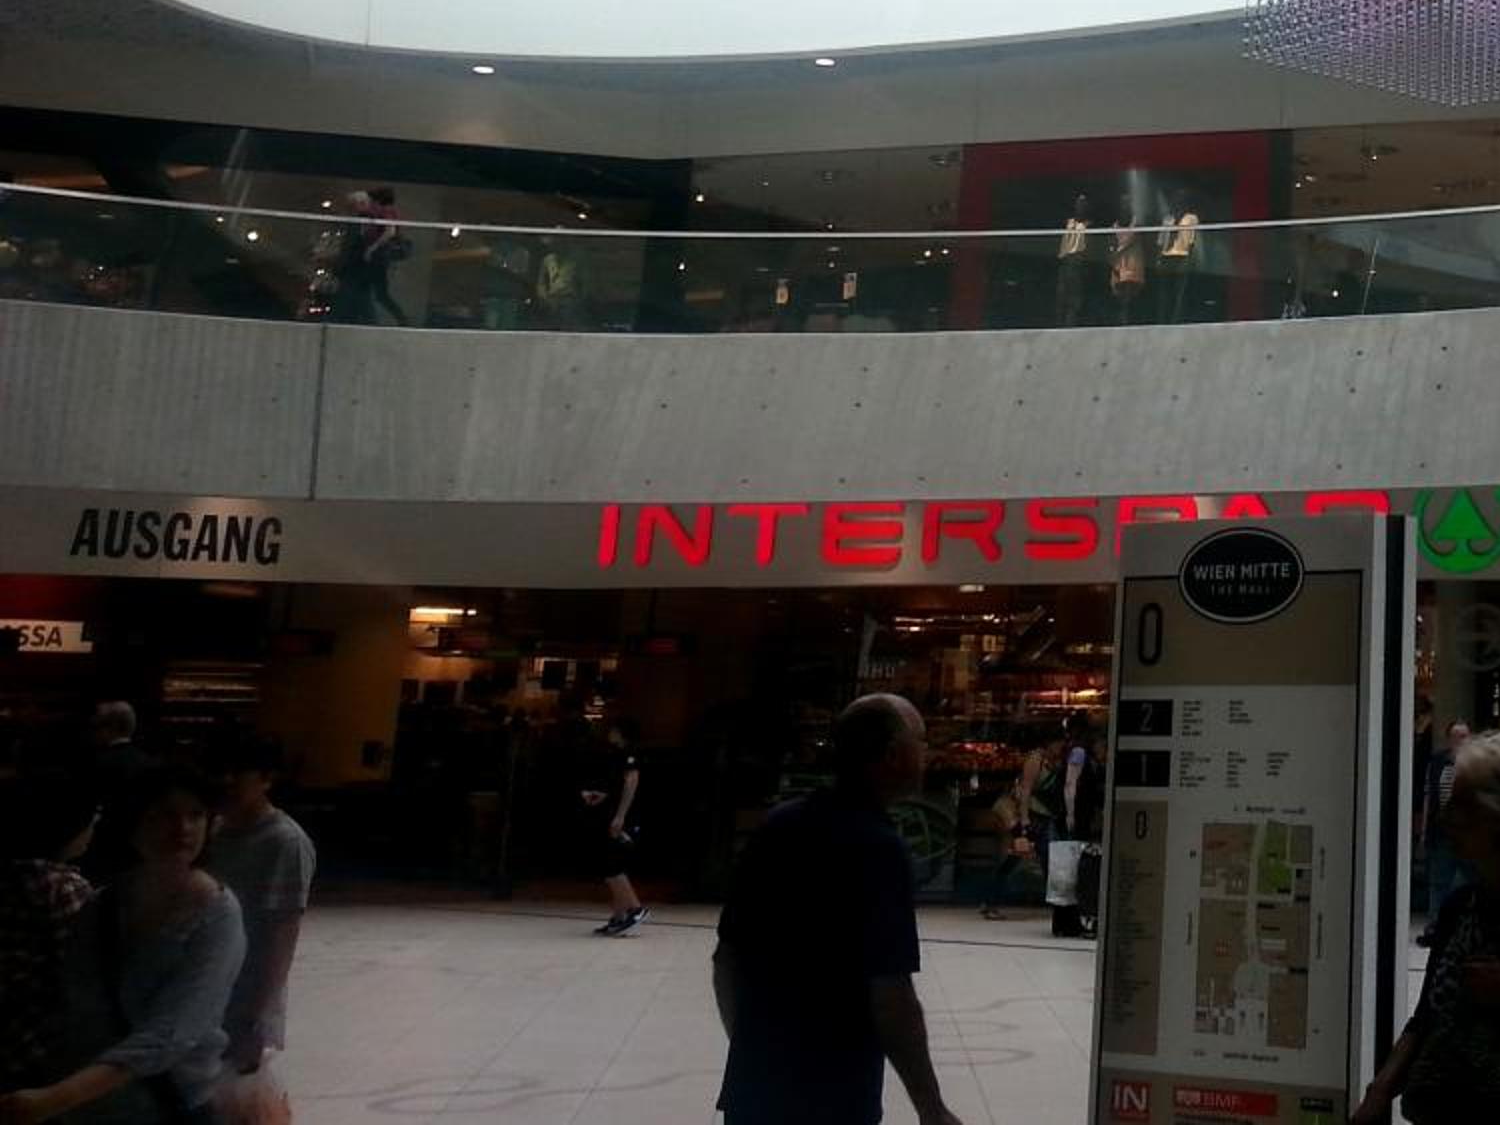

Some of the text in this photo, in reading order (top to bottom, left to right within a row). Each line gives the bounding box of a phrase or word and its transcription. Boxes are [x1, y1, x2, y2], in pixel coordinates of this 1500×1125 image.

[70, 508, 283, 565] AUSGANG
[1193, 562, 1291, 580] WIEN MITTE
[1138, 702, 1153, 733] 2
